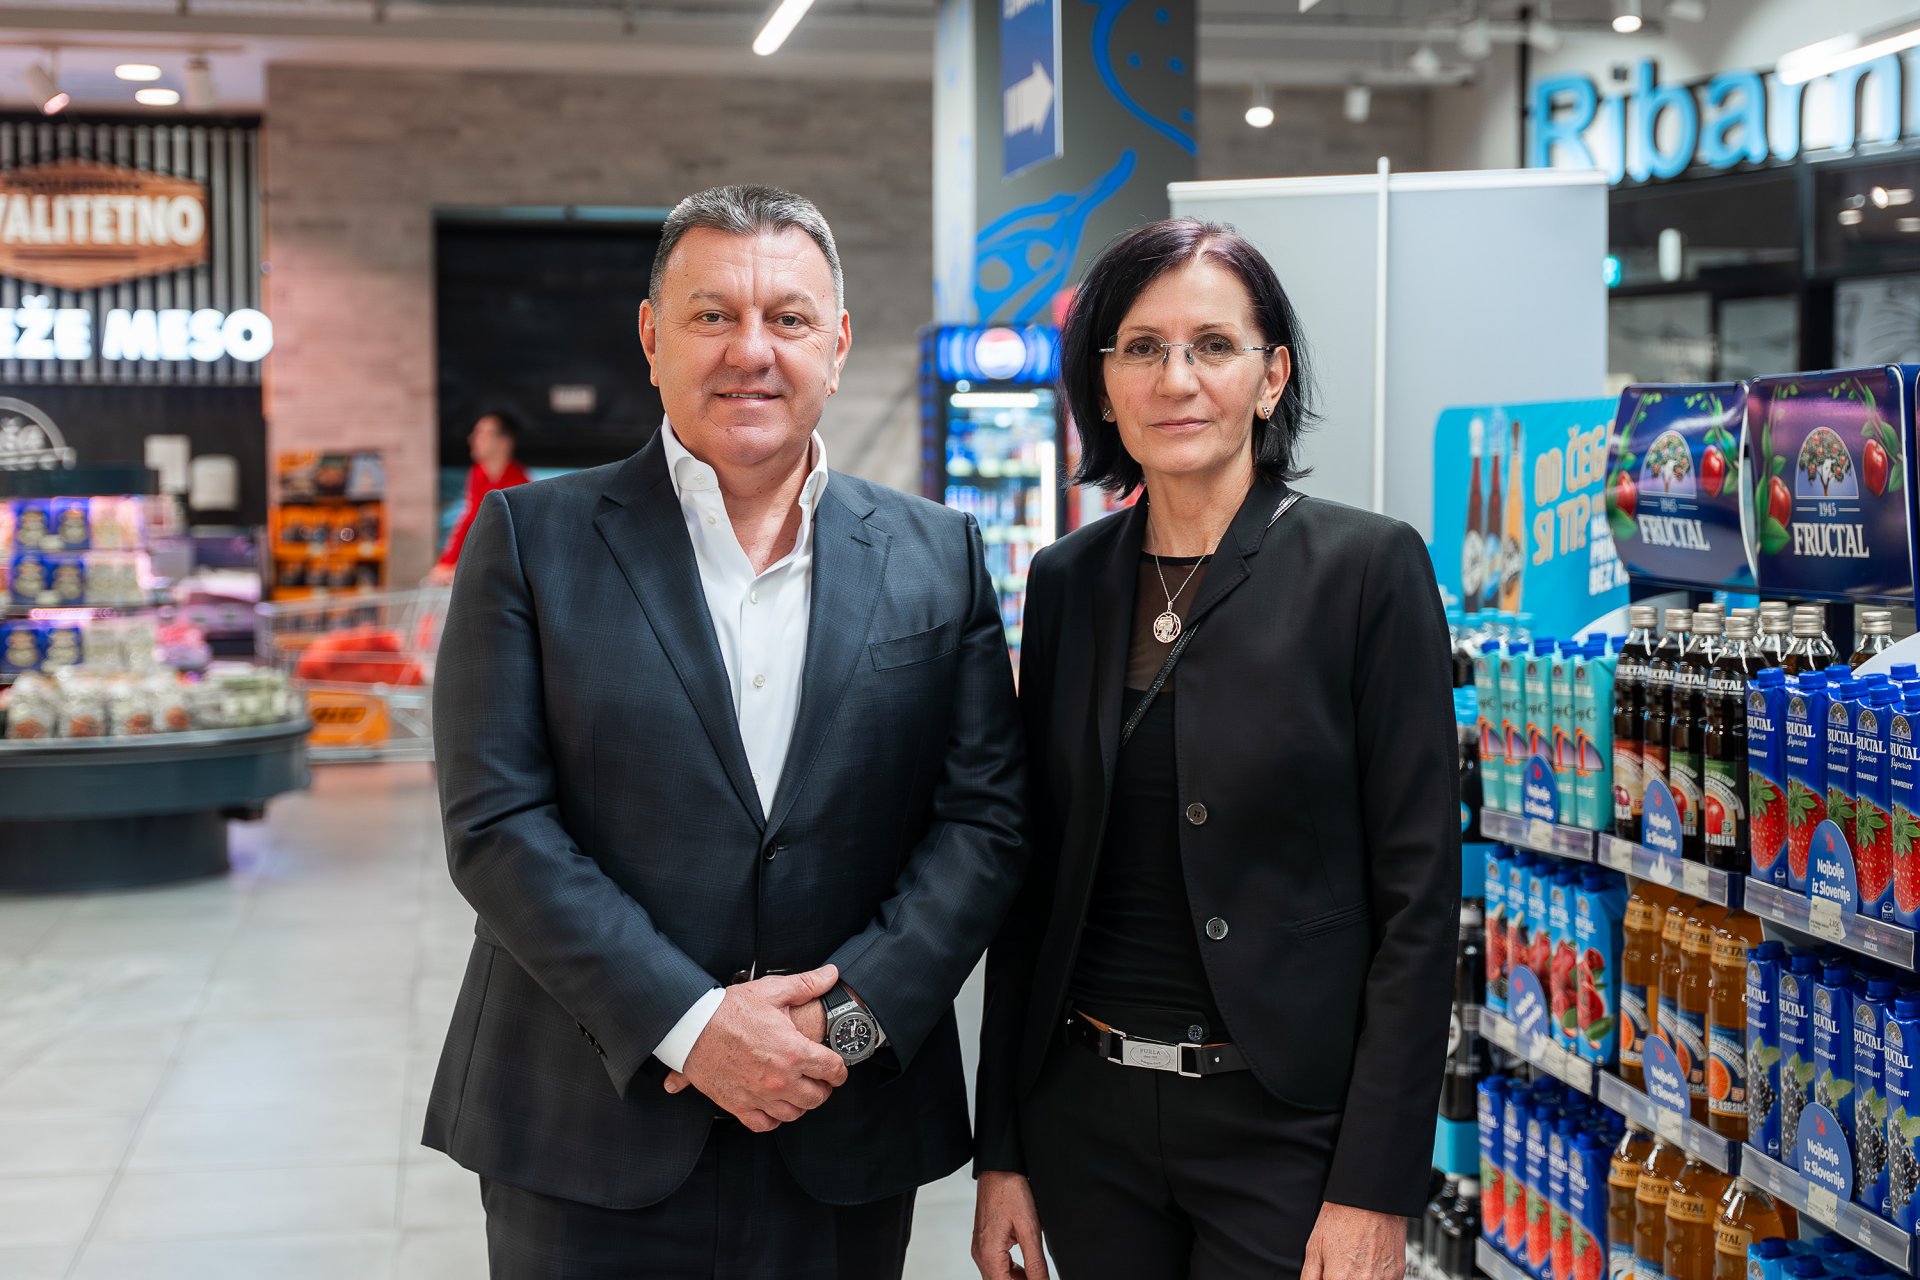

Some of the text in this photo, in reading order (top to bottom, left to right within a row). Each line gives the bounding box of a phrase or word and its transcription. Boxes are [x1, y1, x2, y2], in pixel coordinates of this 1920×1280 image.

[102, 308, 274, 362] MESO
[1818, 502, 1837, 517] 1945
[1637, 514, 1711, 551] FRUCTAL
[1791, 522, 1870, 558] FRUCTAL
[1707, 677, 1745, 692] RUCTAL
[1747, 715, 1775, 732] RUCTAL
[1786, 721, 1816, 738] RUCTAL
[1827, 728, 1857, 746] RUCTAL
[1856, 735, 1887, 754] RUCTAL
[1890, 742, 1920, 760] RUCTAL
[1817, 858, 1845, 882] Najbolje
[1812, 878, 1851, 904] iz Slovenije
[1779, 998, 1808, 1018] RUCTAL
[1814, 1012, 1840, 1034] RUCTAL
[1853, 1028, 1884, 1051] RUCTAL
[1884, 1045, 1913, 1069] RUCTAL
[1807, 1138, 1839, 1167] Najbolje
[1804, 1156, 1845, 1191] iz Slovenije
